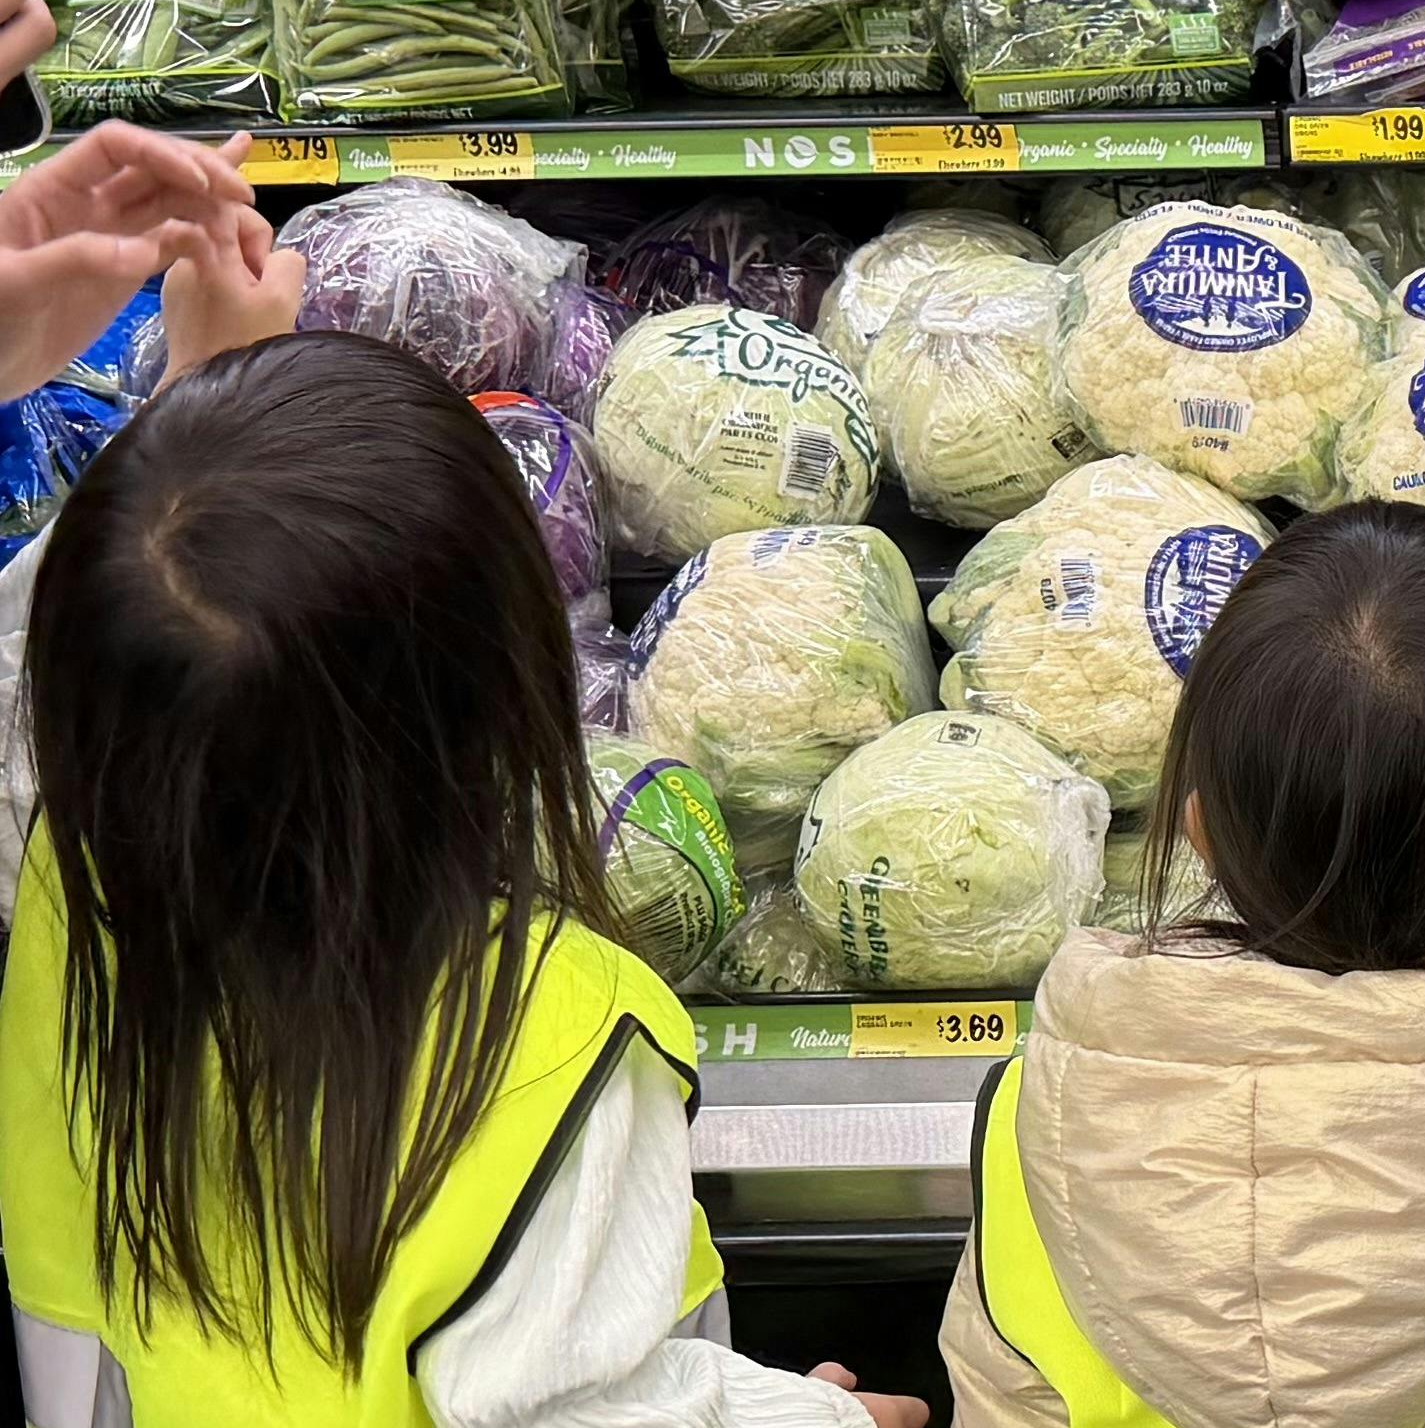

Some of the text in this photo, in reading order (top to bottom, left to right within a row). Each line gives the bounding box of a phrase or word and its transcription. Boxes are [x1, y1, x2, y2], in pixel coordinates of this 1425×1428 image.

[716, 71, 769, 91] WEIGHT
[822, 71, 846, 90] NET
[847, 71, 872, 89] 283
[885, 71, 901, 87] 10
[998, 80, 1229, 110] NET WEIGHT POIDS NET 283 10 oz
[943, 124, 1003, 150] $2.99
[1372, 114, 1424, 141] $1.99
[268, 136, 328, 162] $3.79
[459, 131, 519, 156] $3.99
[533, 143, 677, 172] pecialty Healthy
[1094, 134, 1168, 162] Specialty
[1189, 133, 1253, 161] Healthy
[1165, 243, 1263, 273] ANTLE
[1140, 270, 1307, 309] TANIMURA
[738, 330, 870, 412] Organic
[664, 773, 729, 856] Organic
[936, 1014, 1004, 1044] $3.69
